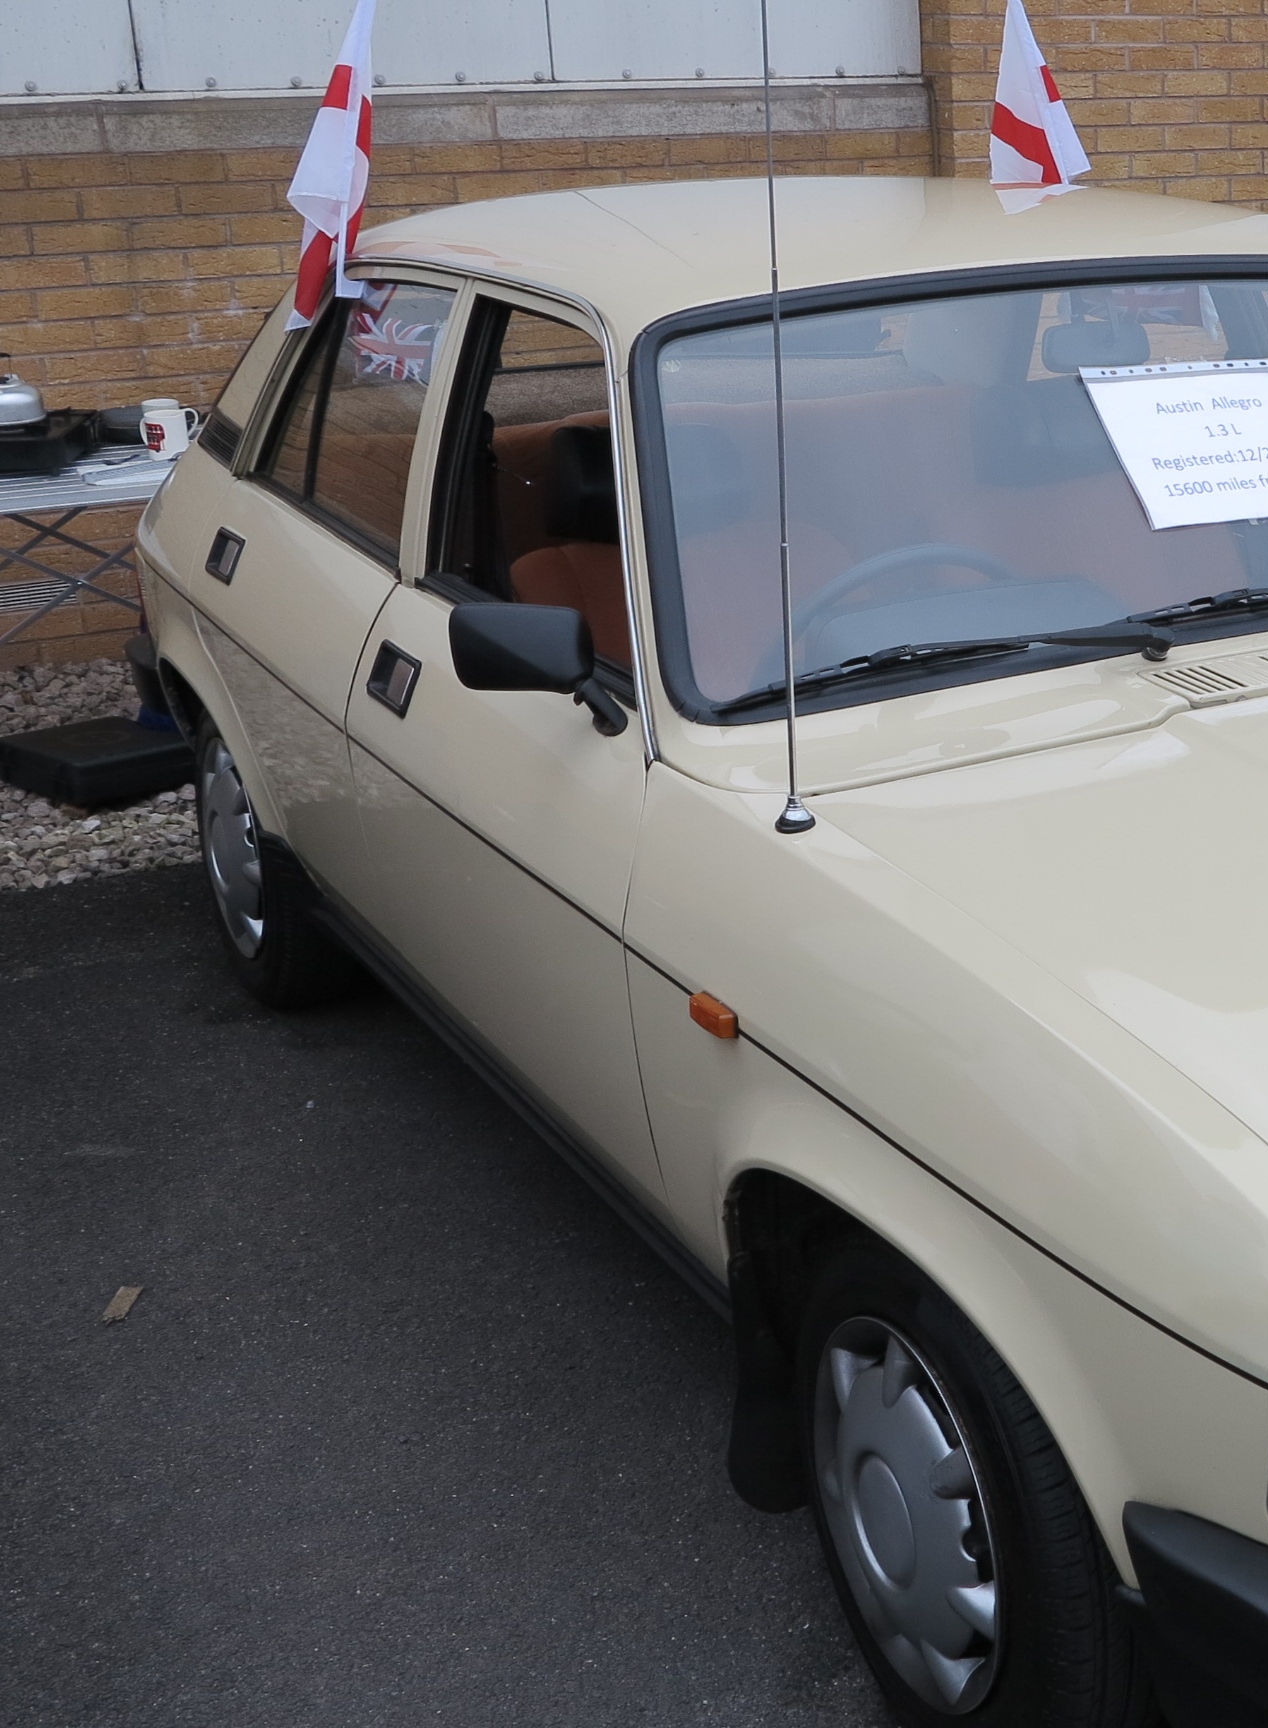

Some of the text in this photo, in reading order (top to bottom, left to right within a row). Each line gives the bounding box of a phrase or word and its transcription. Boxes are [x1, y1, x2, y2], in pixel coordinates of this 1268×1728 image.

[1156, 396, 1262, 415] Austin Allegro
[1204, 423, 1242, 438] 1.3 L
[1164, 480, 1213, 497] 15600
[1217, 476, 1257, 492] miles
